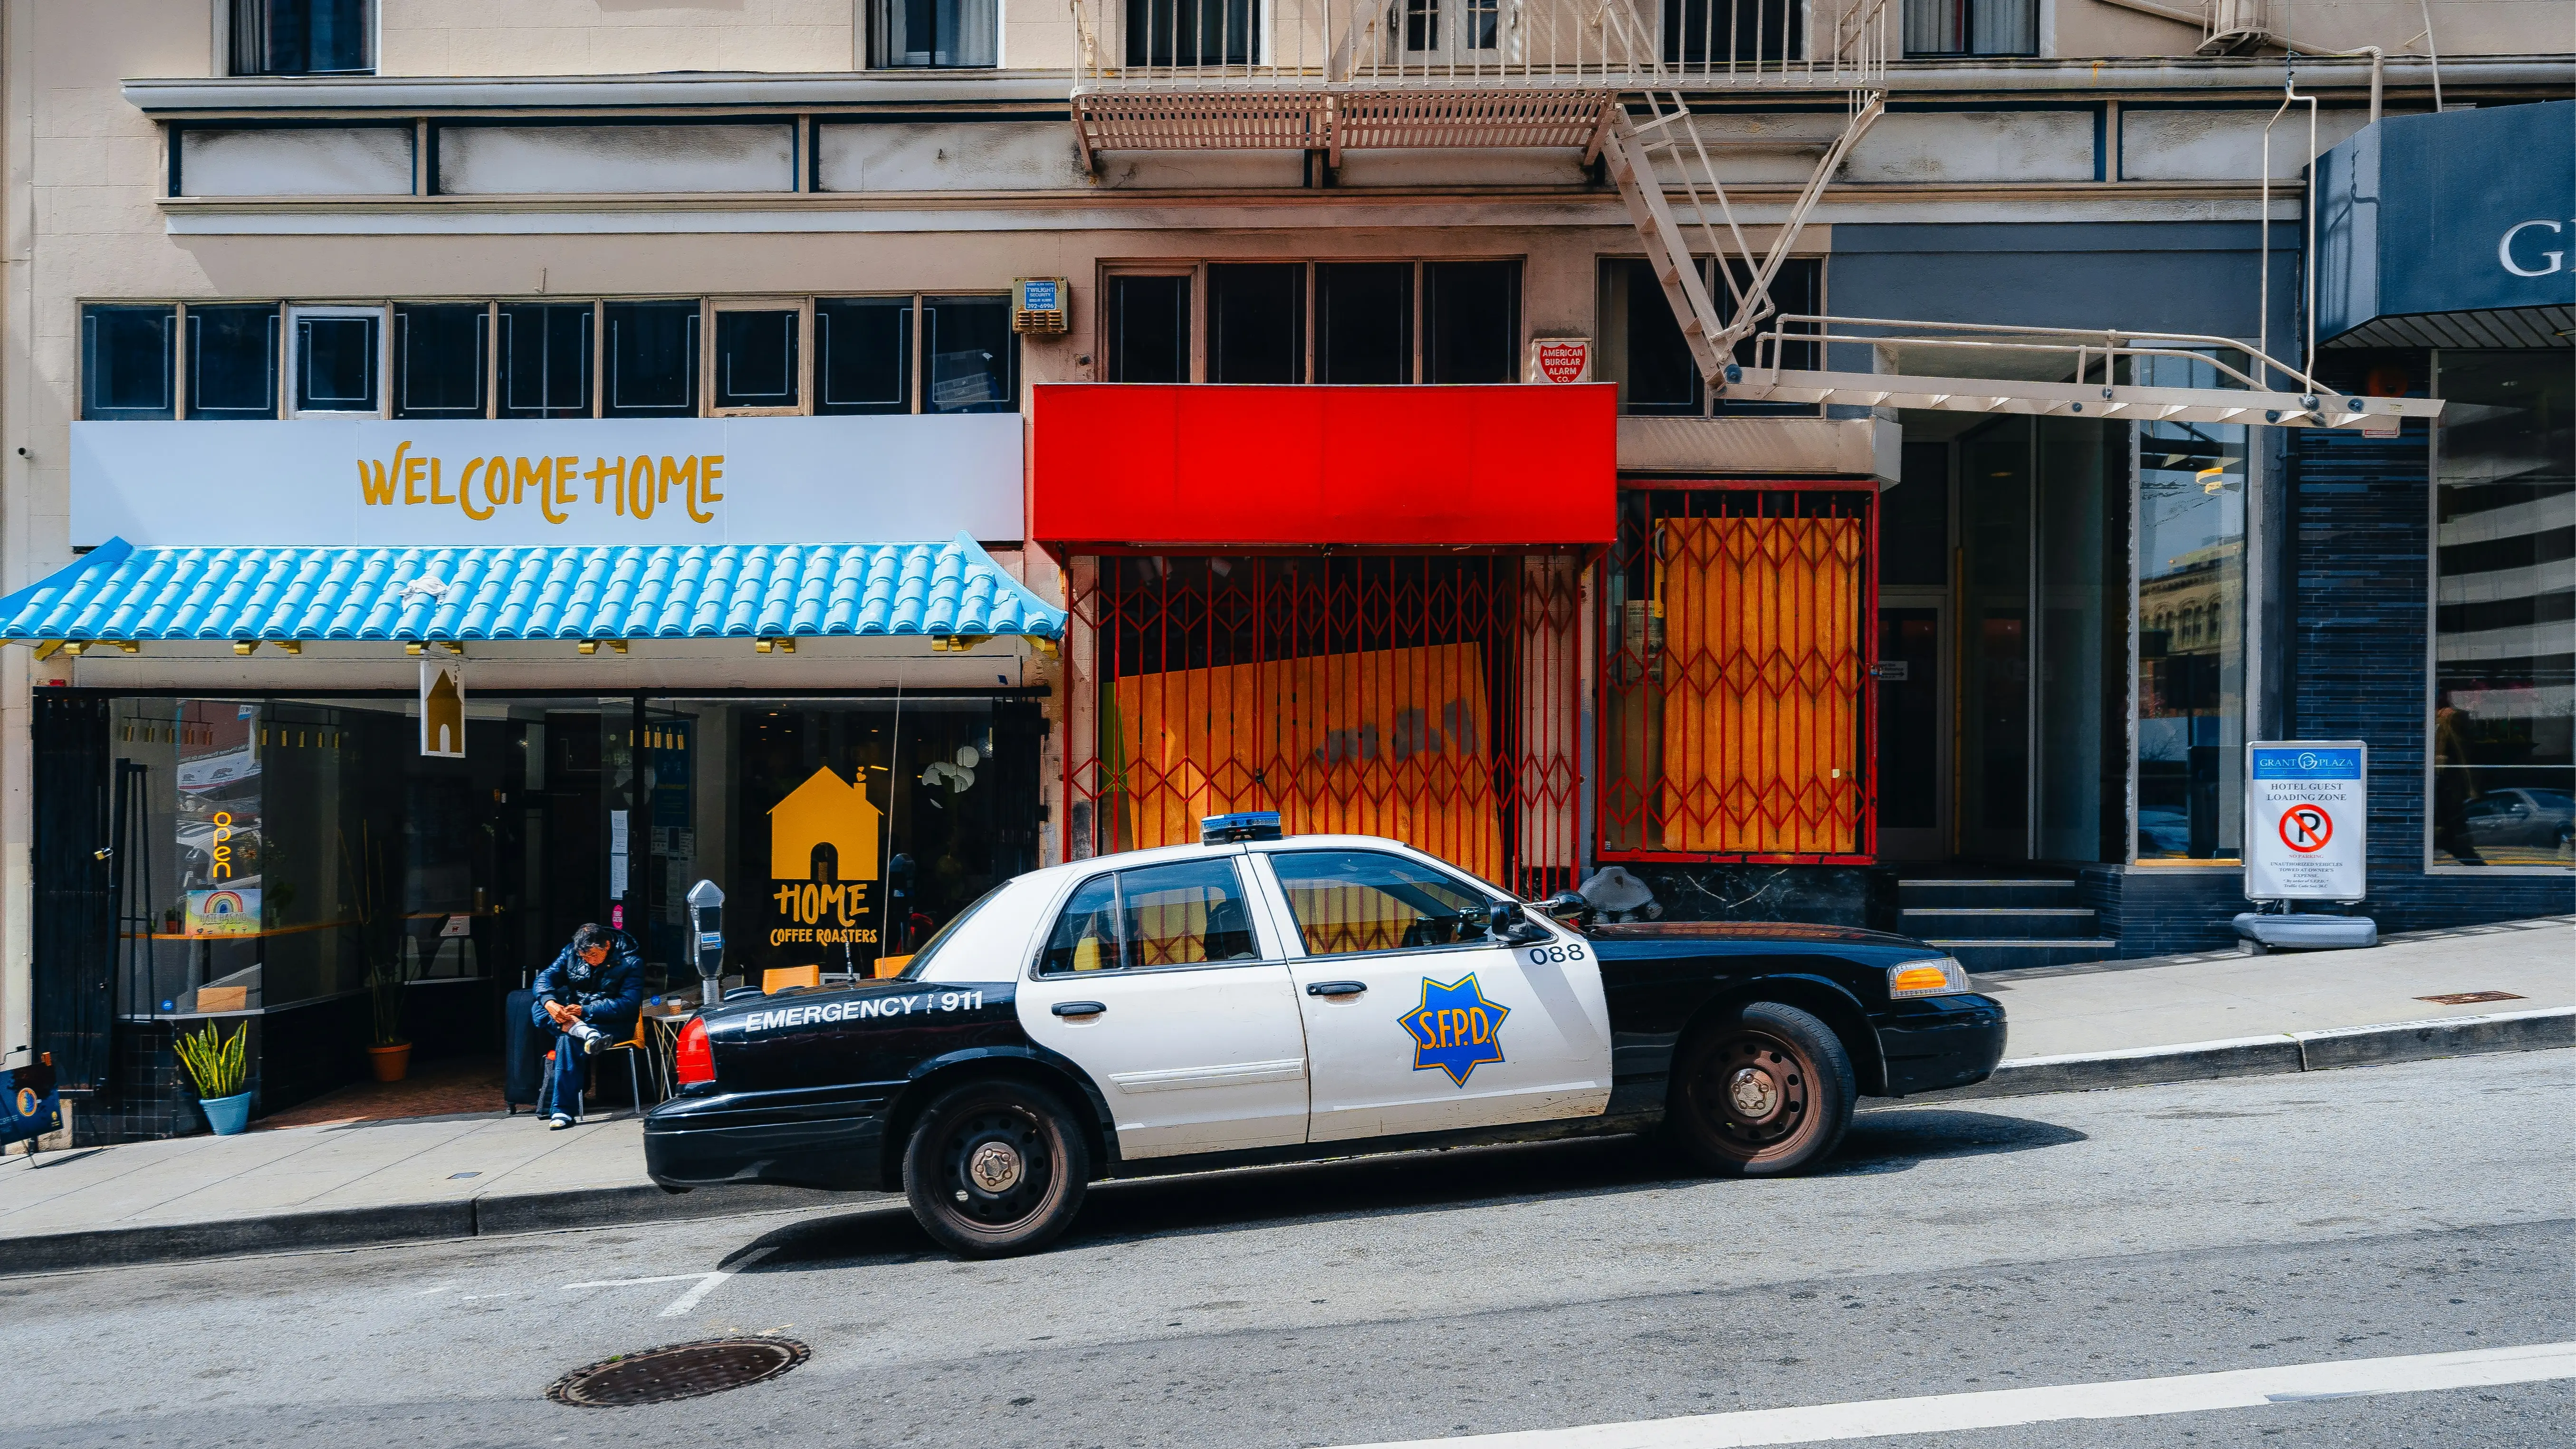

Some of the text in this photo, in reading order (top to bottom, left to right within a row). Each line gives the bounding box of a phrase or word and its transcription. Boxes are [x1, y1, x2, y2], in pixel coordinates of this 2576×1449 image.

[1542, 349, 1583, 357] AMERICAN
[357, 441, 725, 524] WELCOME HOME
[2319, 758, 2353, 767] PLAZA
[773, 884, 870, 927] HOME
[200, 912, 247, 923] HATE HAS NO
[770, 929, 877, 947] COFFEE ROASTERS
[1529, 944, 1585, 965] 088
[745, 995, 920, 1033] EMERGENCY
[941, 990, 983, 1011] 911
[1418, 1007, 1491, 1050] S.F.P.D.
